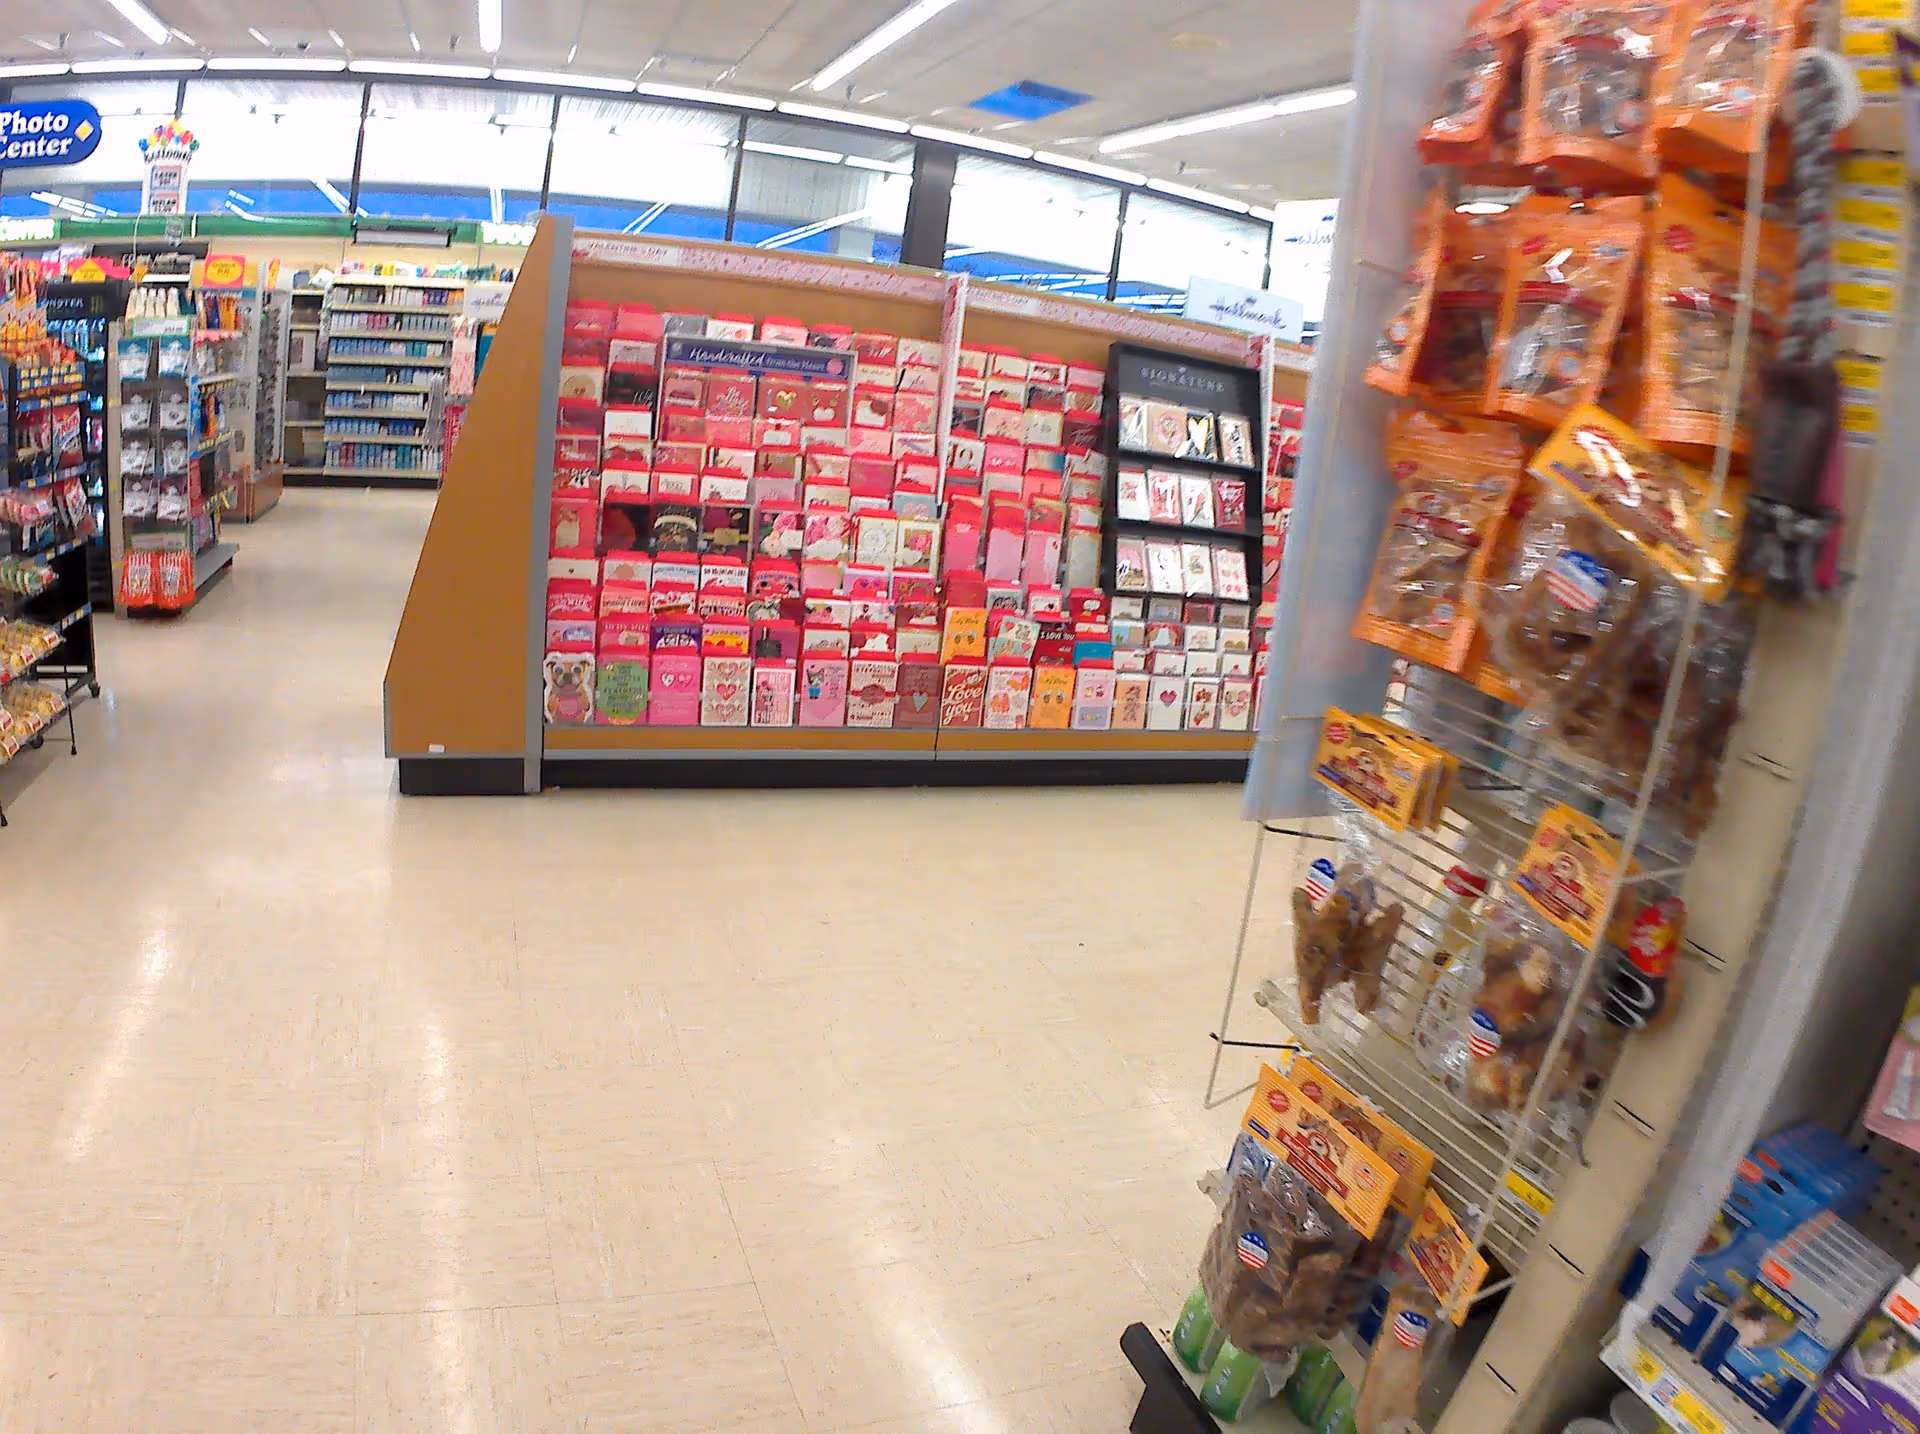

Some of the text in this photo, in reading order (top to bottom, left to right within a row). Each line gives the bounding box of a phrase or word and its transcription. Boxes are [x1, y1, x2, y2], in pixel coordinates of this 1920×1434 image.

[0, 110, 69, 135] Photo
[1209, 296, 1287, 329] Hallmark
[689, 347, 766, 369] Handcrafted
[944, 683, 982, 703] Love
[943, 702, 973, 725] you
